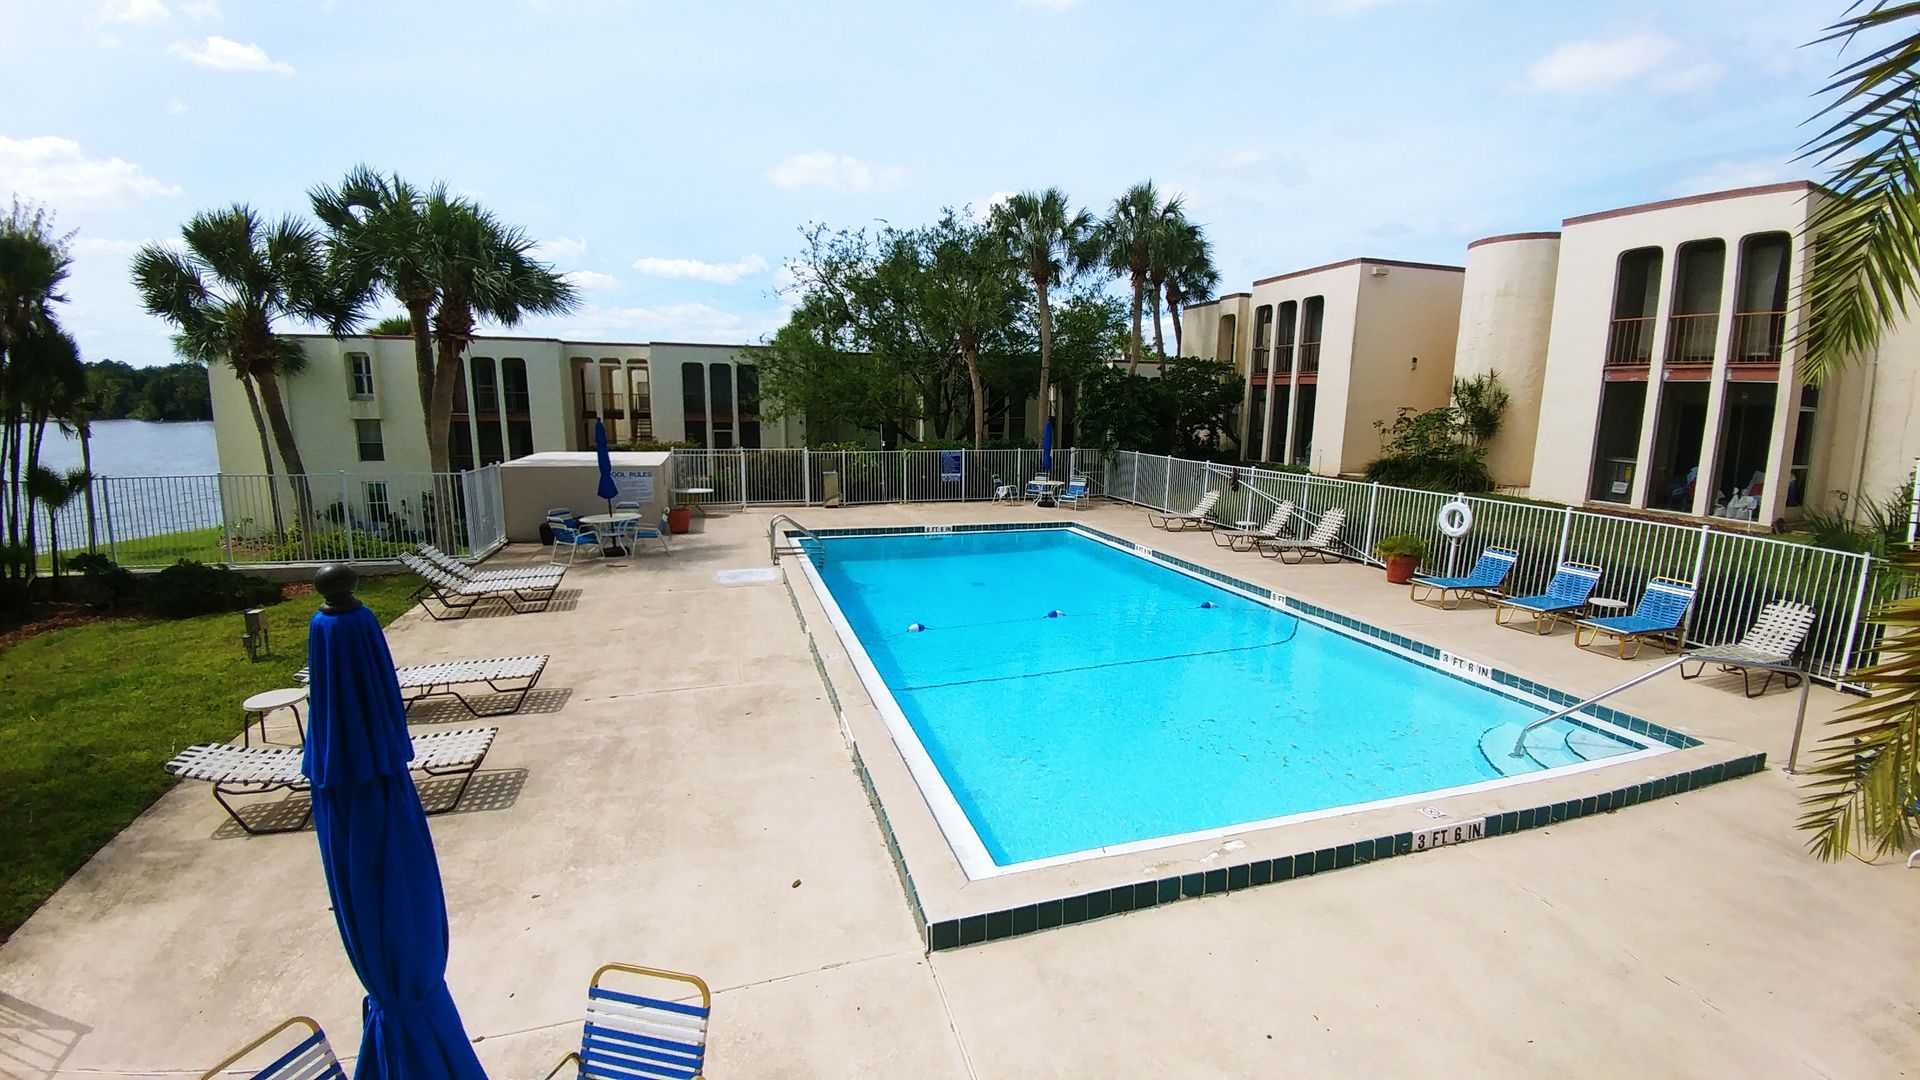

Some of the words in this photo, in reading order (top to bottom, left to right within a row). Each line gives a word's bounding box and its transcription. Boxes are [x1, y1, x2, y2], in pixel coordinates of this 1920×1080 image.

[1272, 593, 1277, 601] 5
[1442, 653, 1449, 663] 3
[1468, 662, 1475, 673] 6
[1417, 834, 1426, 849] 3
[1454, 826, 1462, 842] 6
[1468, 822, 1483, 840] IN.
